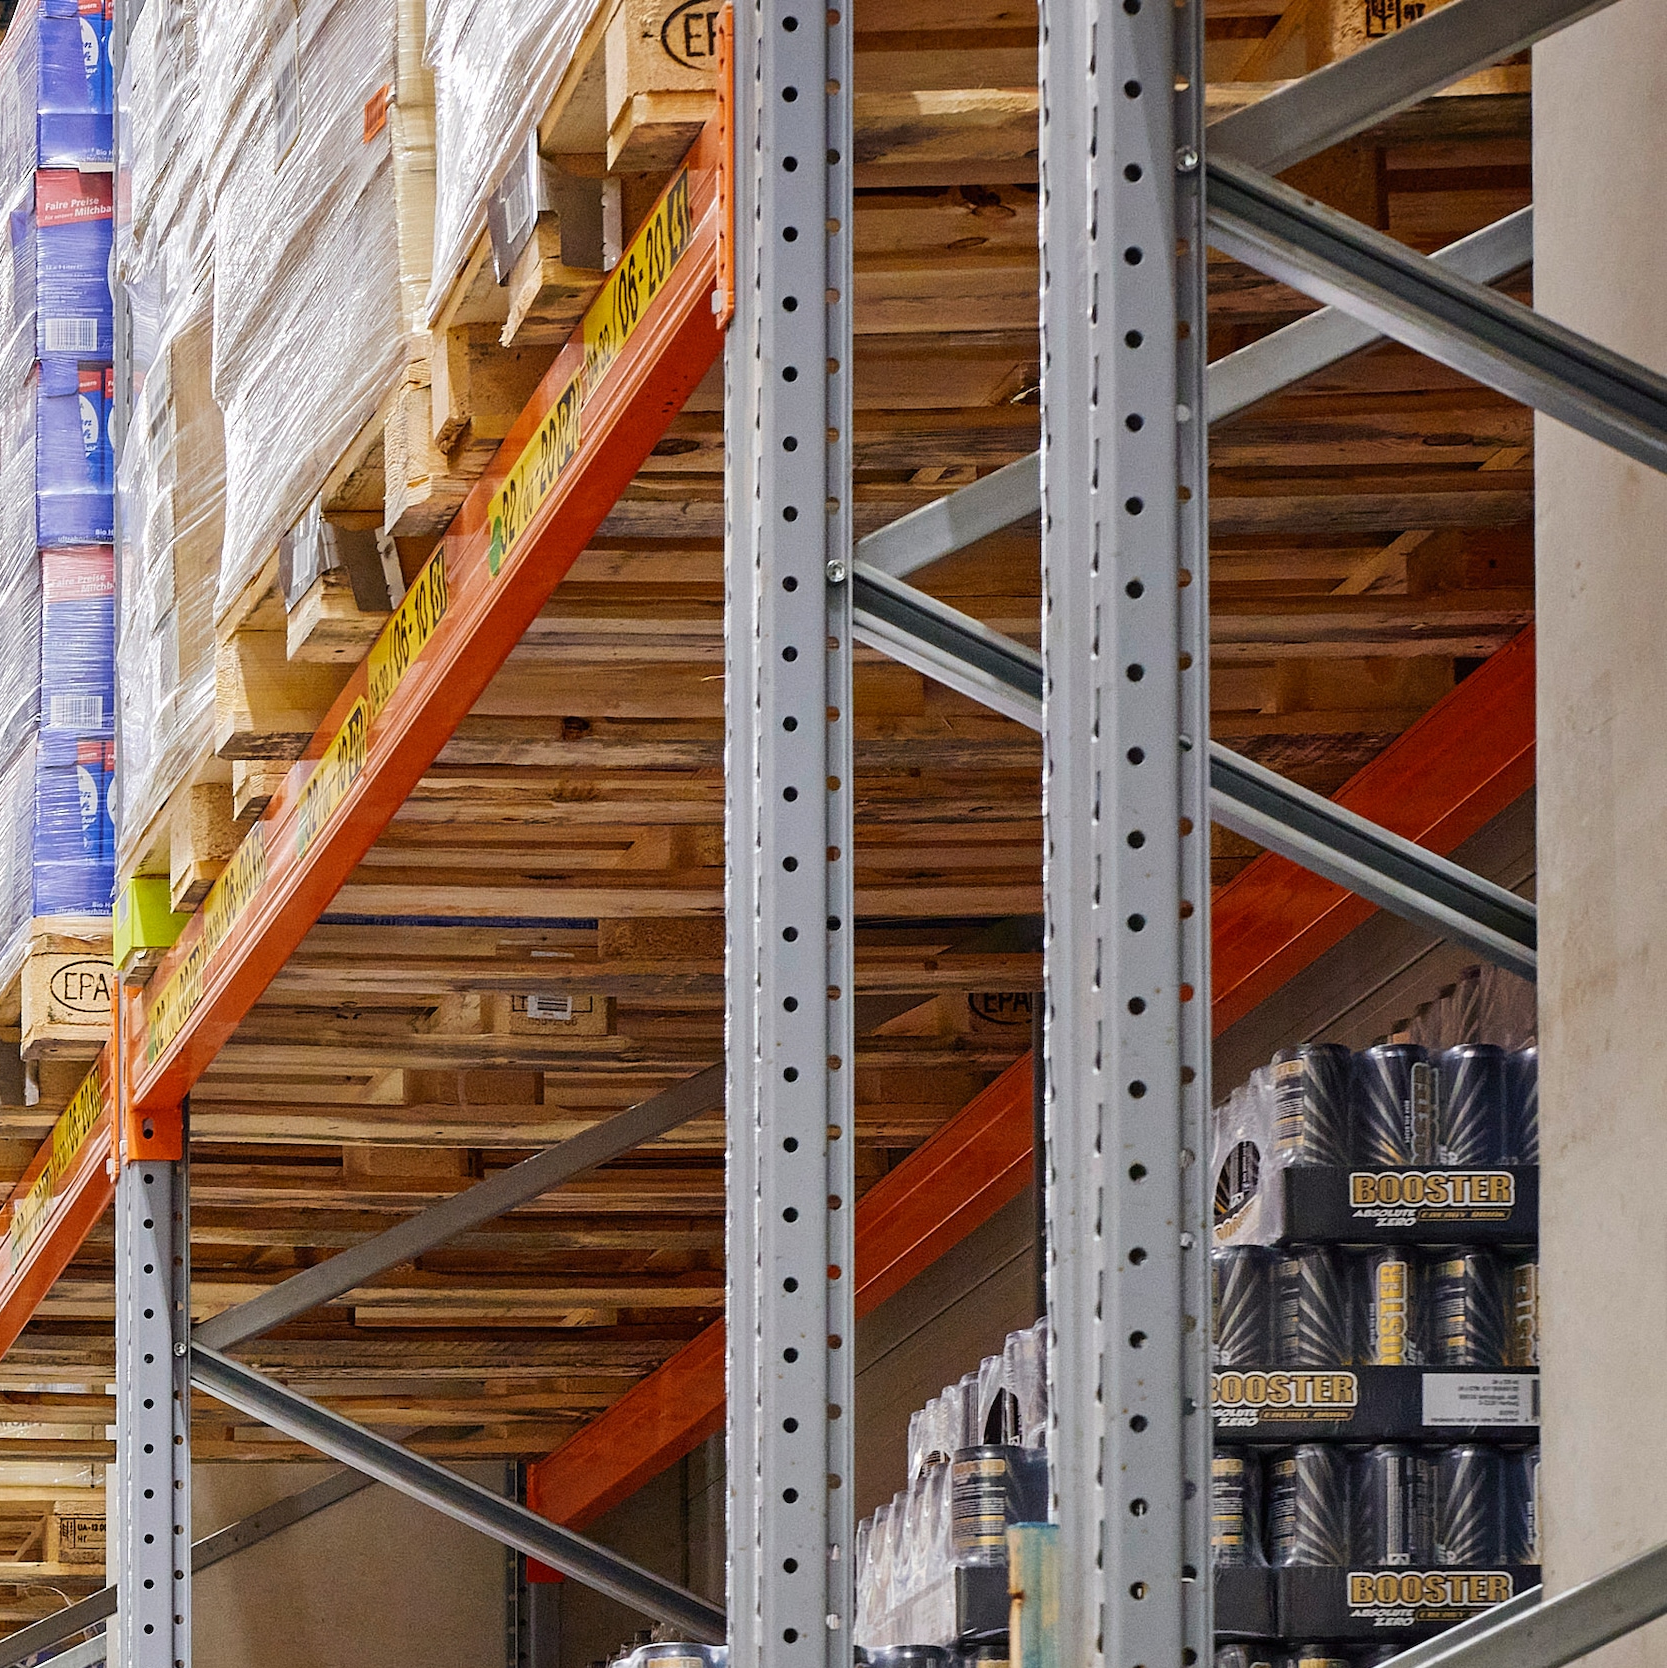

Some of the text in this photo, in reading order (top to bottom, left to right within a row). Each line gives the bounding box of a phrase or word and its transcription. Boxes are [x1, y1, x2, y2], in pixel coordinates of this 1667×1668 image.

[44, 197, 99, 211] Faire Preise
[75, 205, 113, 217] Milchba
[64, 973, 110, 1000] EPA
[1353, 1174, 1513, 1204] BOOSTER
[1353, 1209, 1416, 1218] ABSOLUTE
[1375, 1218, 1415, 1227] ZERO
[1379, 1263, 1404, 1364] OOSTER
[1212, 1374, 1356, 1403] OOSTER
[1213, 1409, 1258, 1418] SOLUTE
[1218, 1417, 1258, 1426] ZERO
[1351, 1574, 1510, 1603] BOOSTER
[1351, 1609, 1414, 1617] ABSOLUTE
[1373, 1617, 1414, 1626] ZERO
